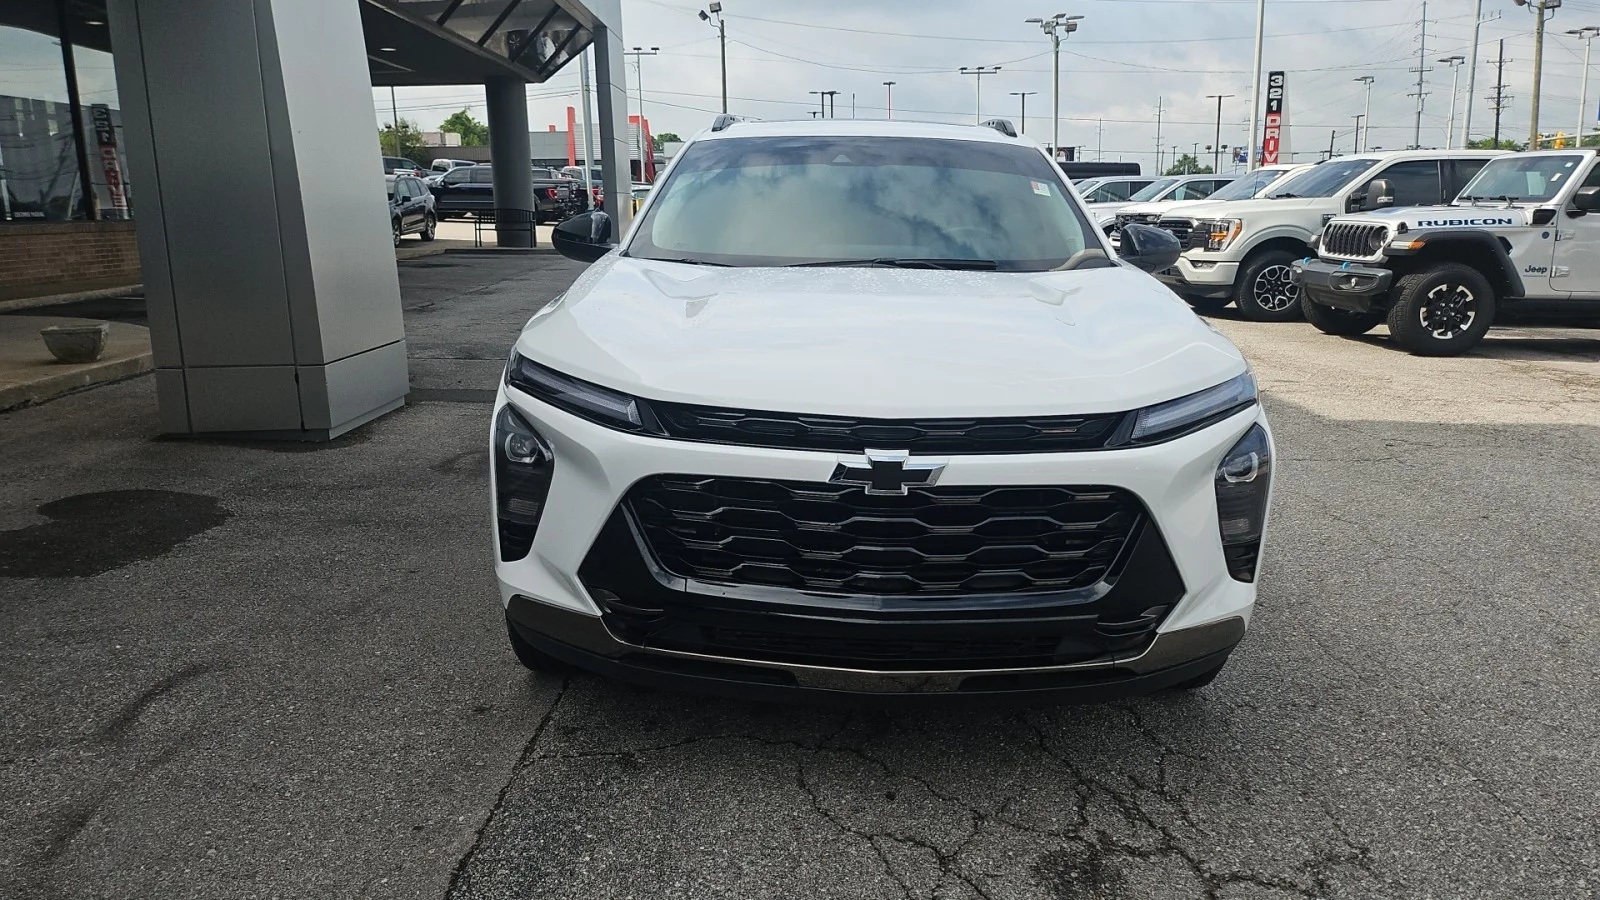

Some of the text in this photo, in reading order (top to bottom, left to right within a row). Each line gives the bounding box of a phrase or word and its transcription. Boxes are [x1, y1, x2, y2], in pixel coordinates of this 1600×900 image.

[1264, 75, 1283, 166] 321 DRIV
[1418, 218, 1512, 227] RUBICON
[1524, 264, 1547, 274] Jeep
